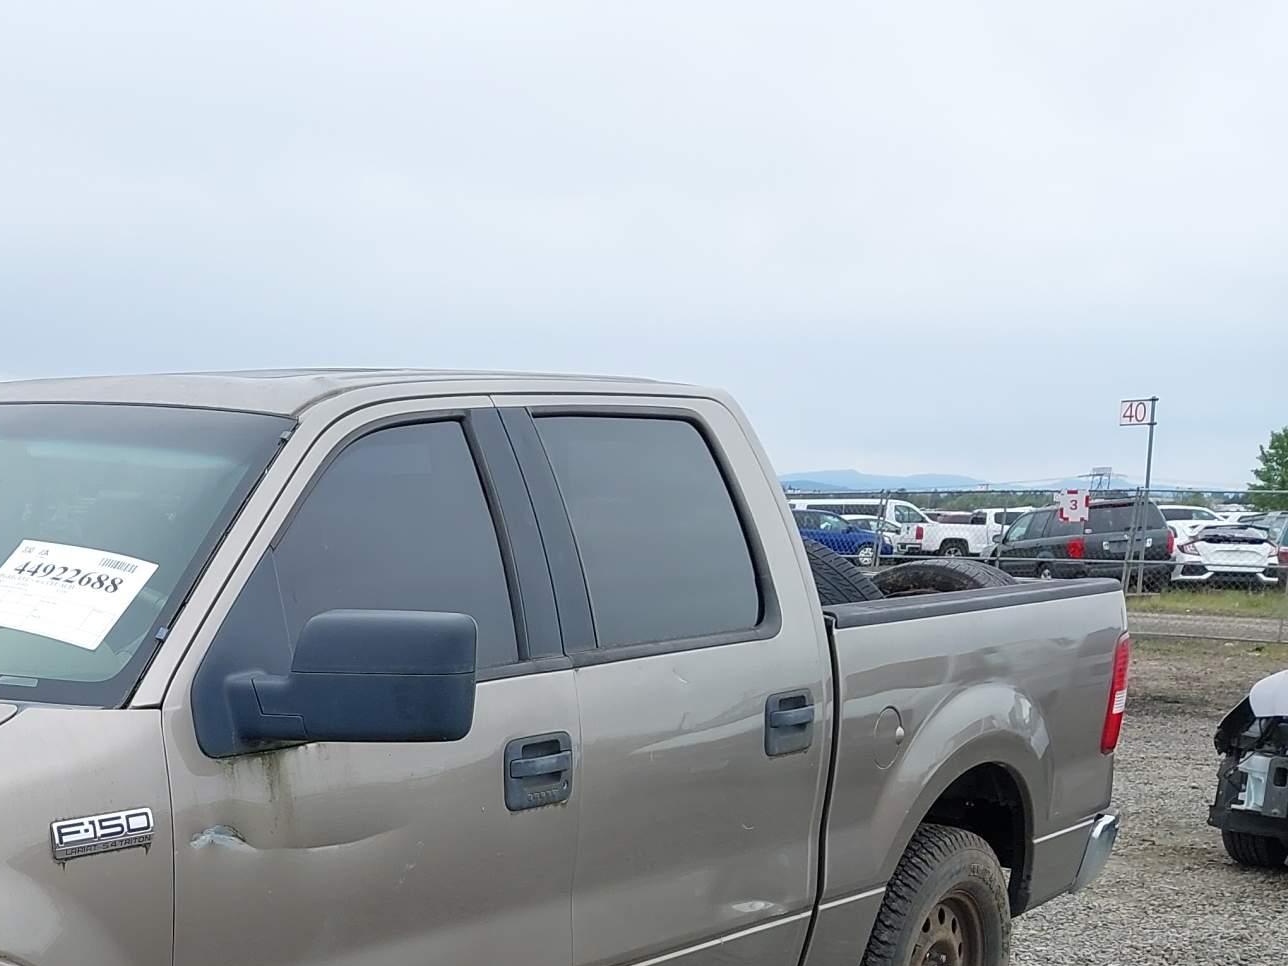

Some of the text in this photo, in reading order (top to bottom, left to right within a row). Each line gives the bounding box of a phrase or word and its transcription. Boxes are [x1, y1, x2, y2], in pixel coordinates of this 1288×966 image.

[1122, 402, 1146, 422] 40
[1069, 499, 1078, 511] 3
[14, 560, 124, 594] 44922688
[55, 811, 152, 845] F-150
[65, 844, 98, 856] LARIAT
[120, 834, 152, 846] TRITON
